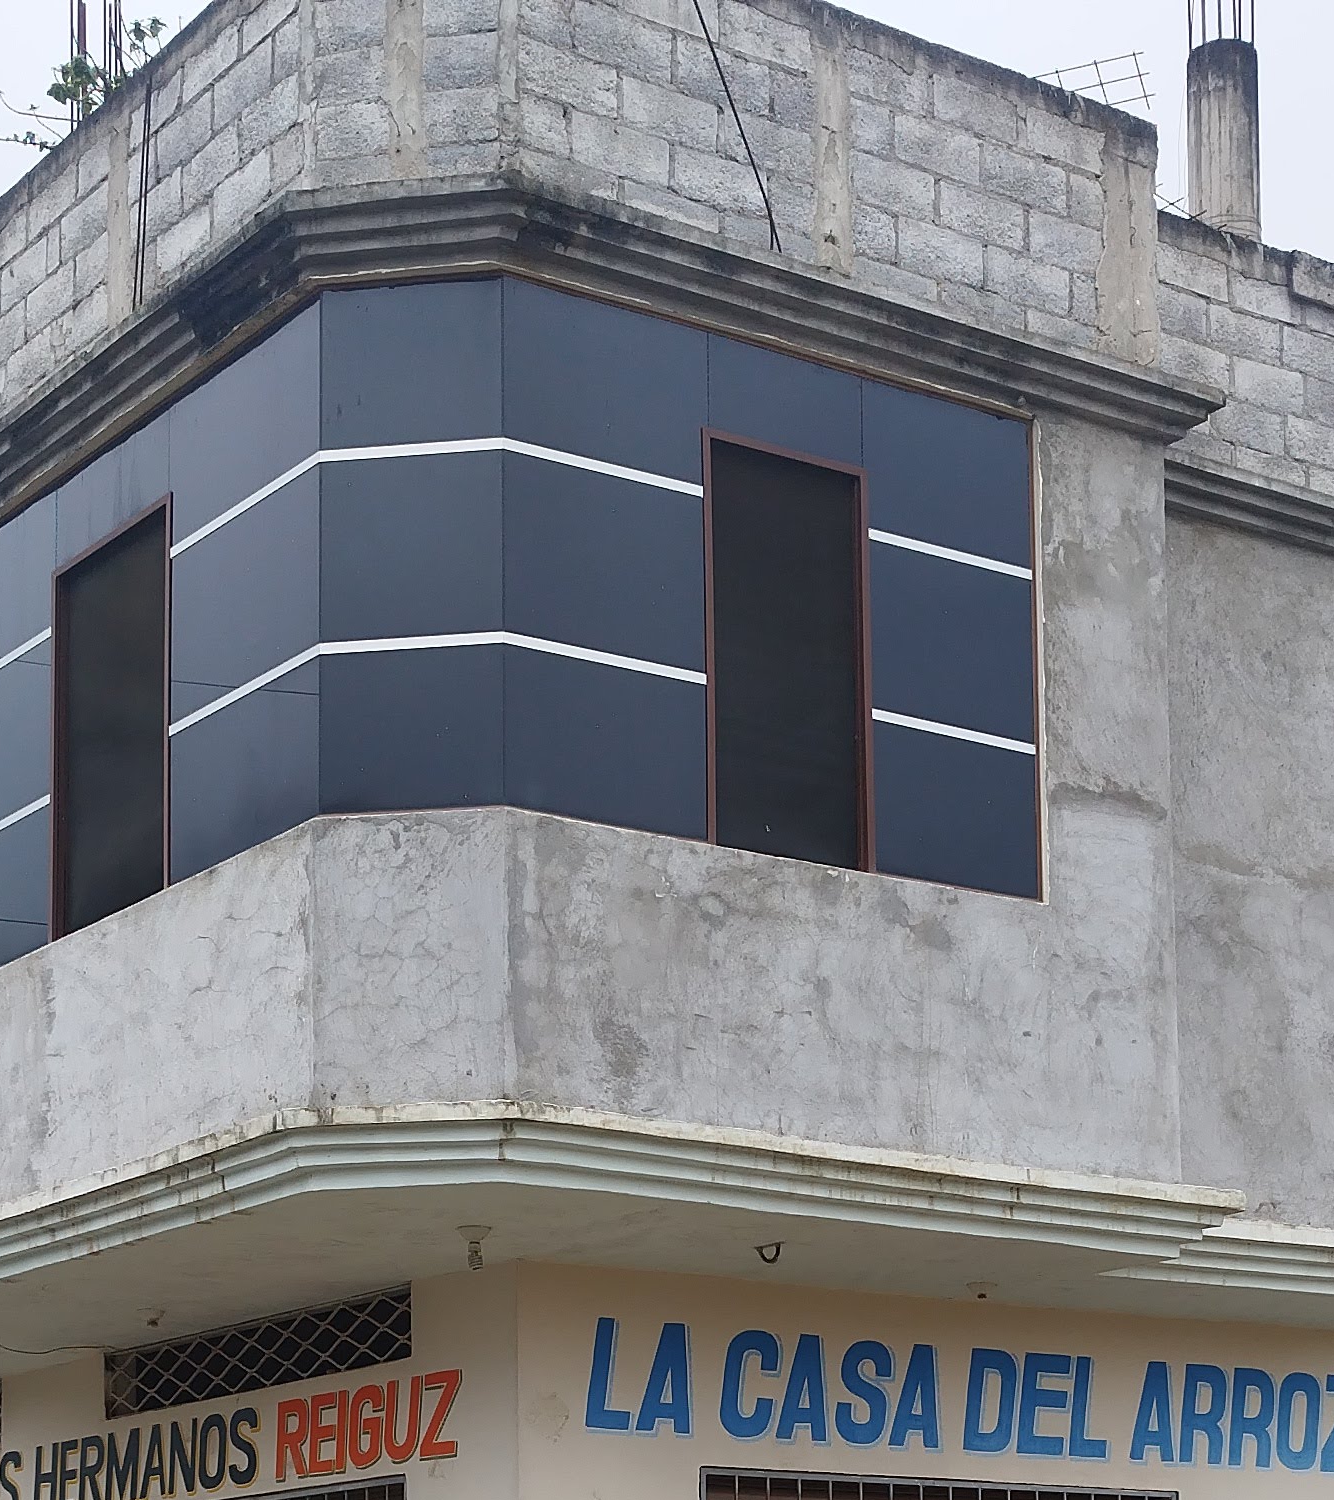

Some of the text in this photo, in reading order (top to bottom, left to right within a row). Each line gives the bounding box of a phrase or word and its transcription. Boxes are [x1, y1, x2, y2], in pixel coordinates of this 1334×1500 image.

[273, 1368, 464, 1482] REIGUZ
[584, 1317, 694, 1437] LA
[718, 1329, 942, 1451] CASA
[963, 1347, 1111, 1462] DEL
